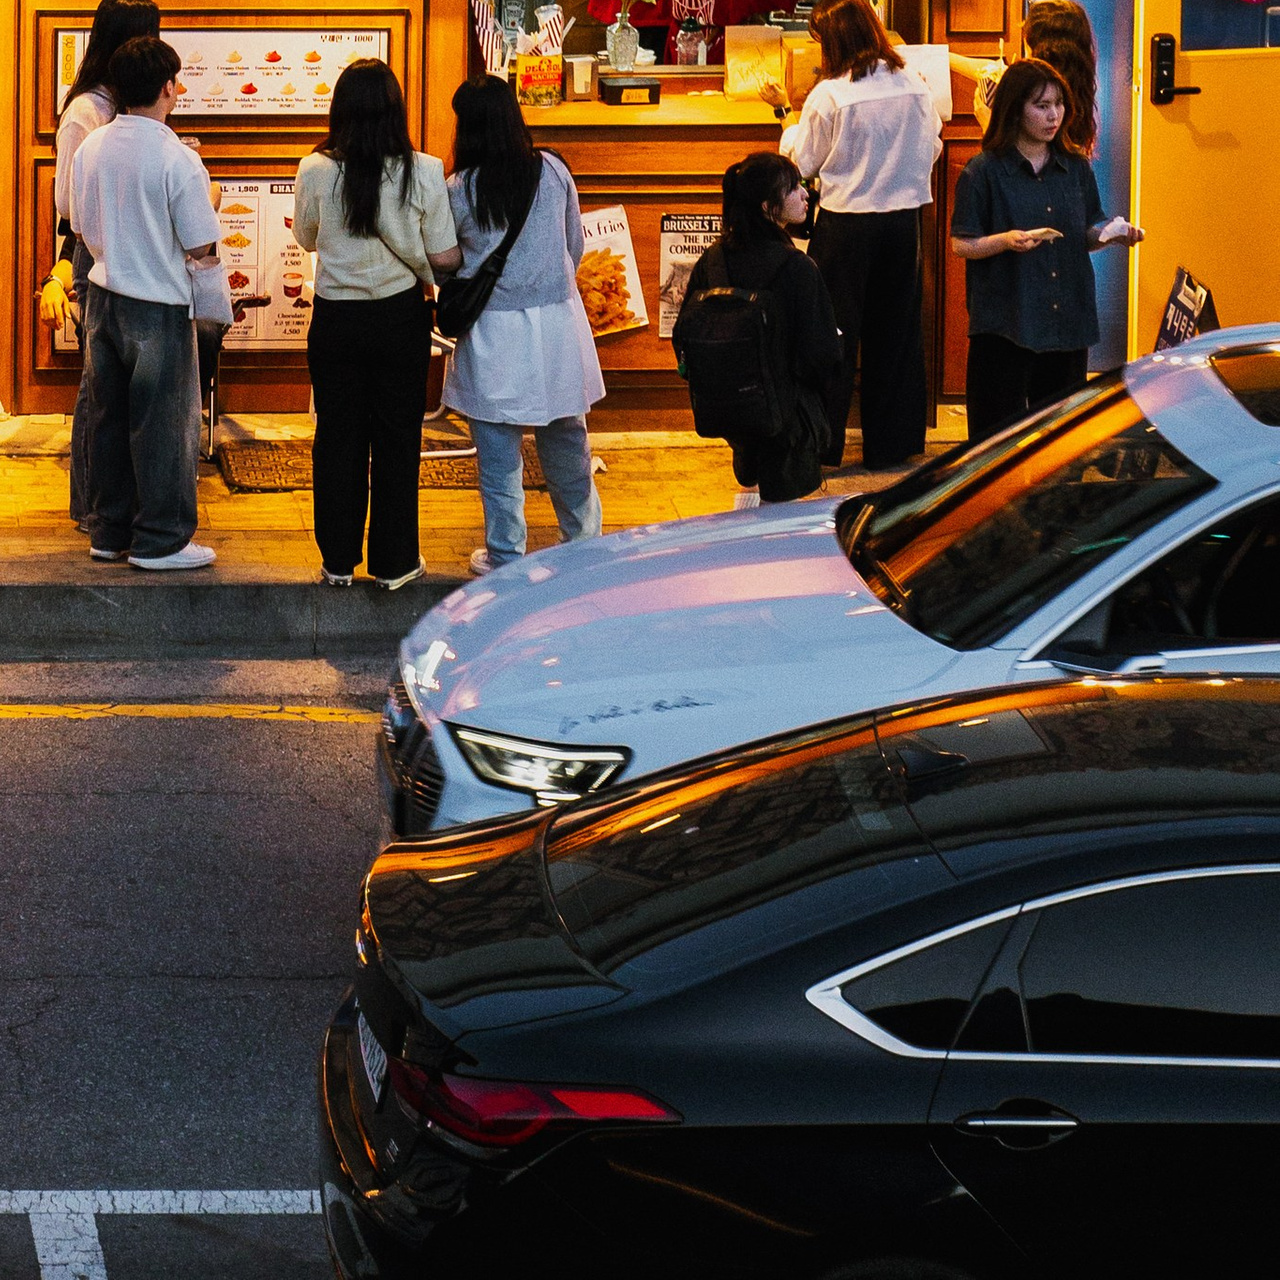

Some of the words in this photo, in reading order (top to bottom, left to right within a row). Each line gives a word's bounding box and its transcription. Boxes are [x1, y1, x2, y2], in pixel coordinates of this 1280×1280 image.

[354, 34, 373, 42] 1000
[597, 220, 625, 236] fries
[663, 220, 710, 231] BRUSSELS
[683, 235, 700, 243] THE
[669, 244, 708, 255] COMBIN
